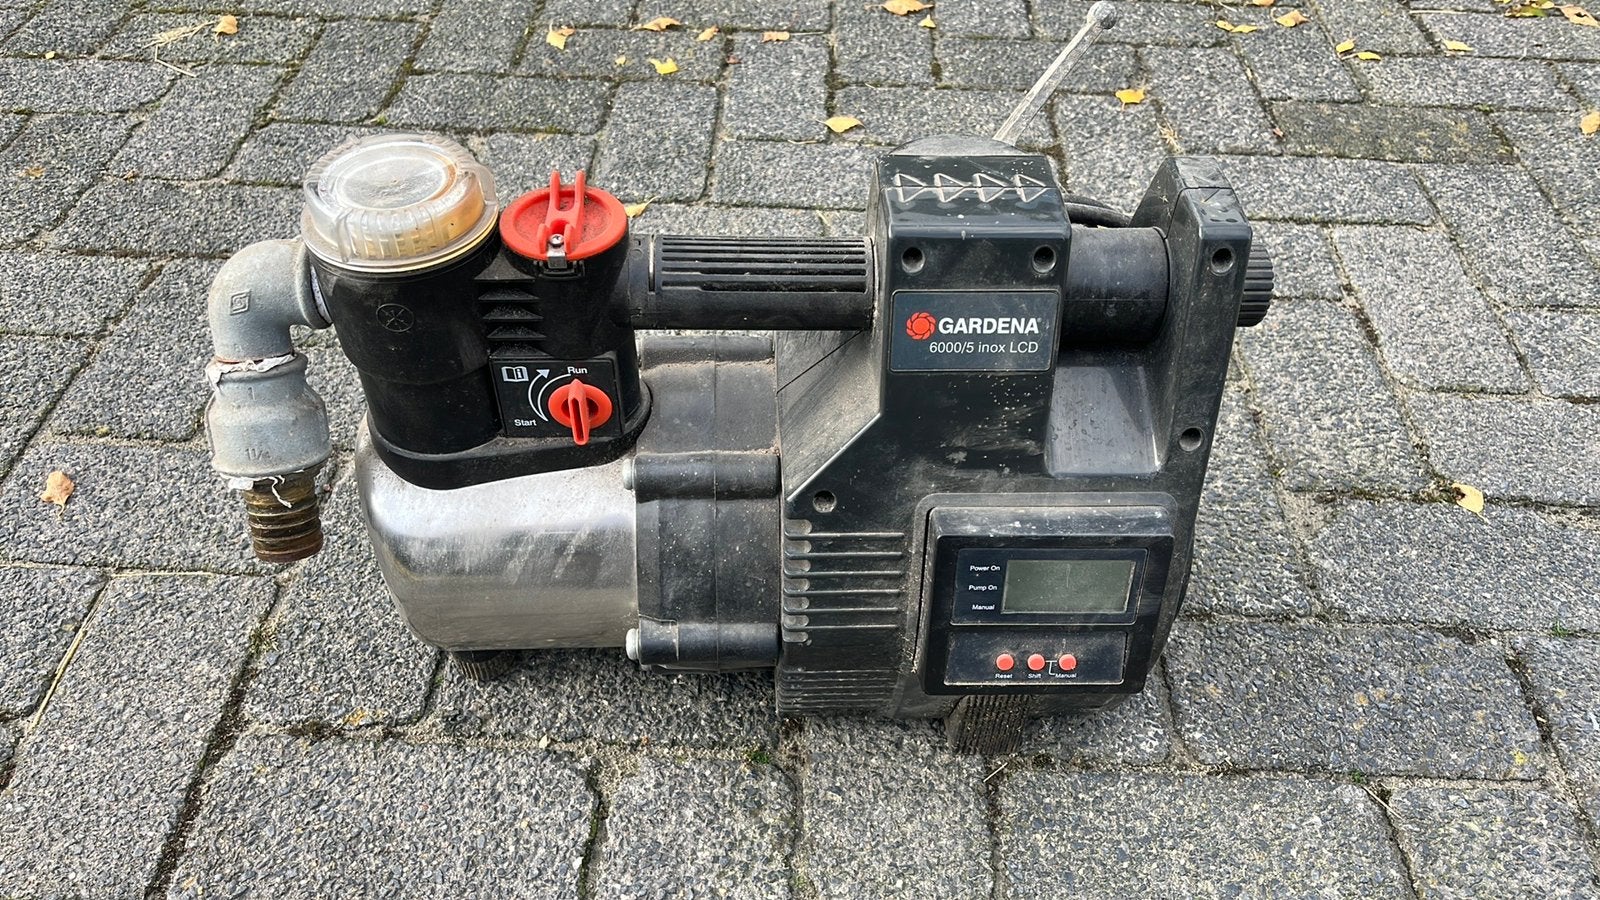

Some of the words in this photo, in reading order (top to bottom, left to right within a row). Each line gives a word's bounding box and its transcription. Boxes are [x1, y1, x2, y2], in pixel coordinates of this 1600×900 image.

[938, 317, 1039, 334] GARDENA
[929, 341, 975, 354] 6000/5
[978, 341, 1006, 353] inox
[1010, 341, 1039, 353] LCD
[567, 366, 588, 375] Run
[514, 418, 537, 427] Start
